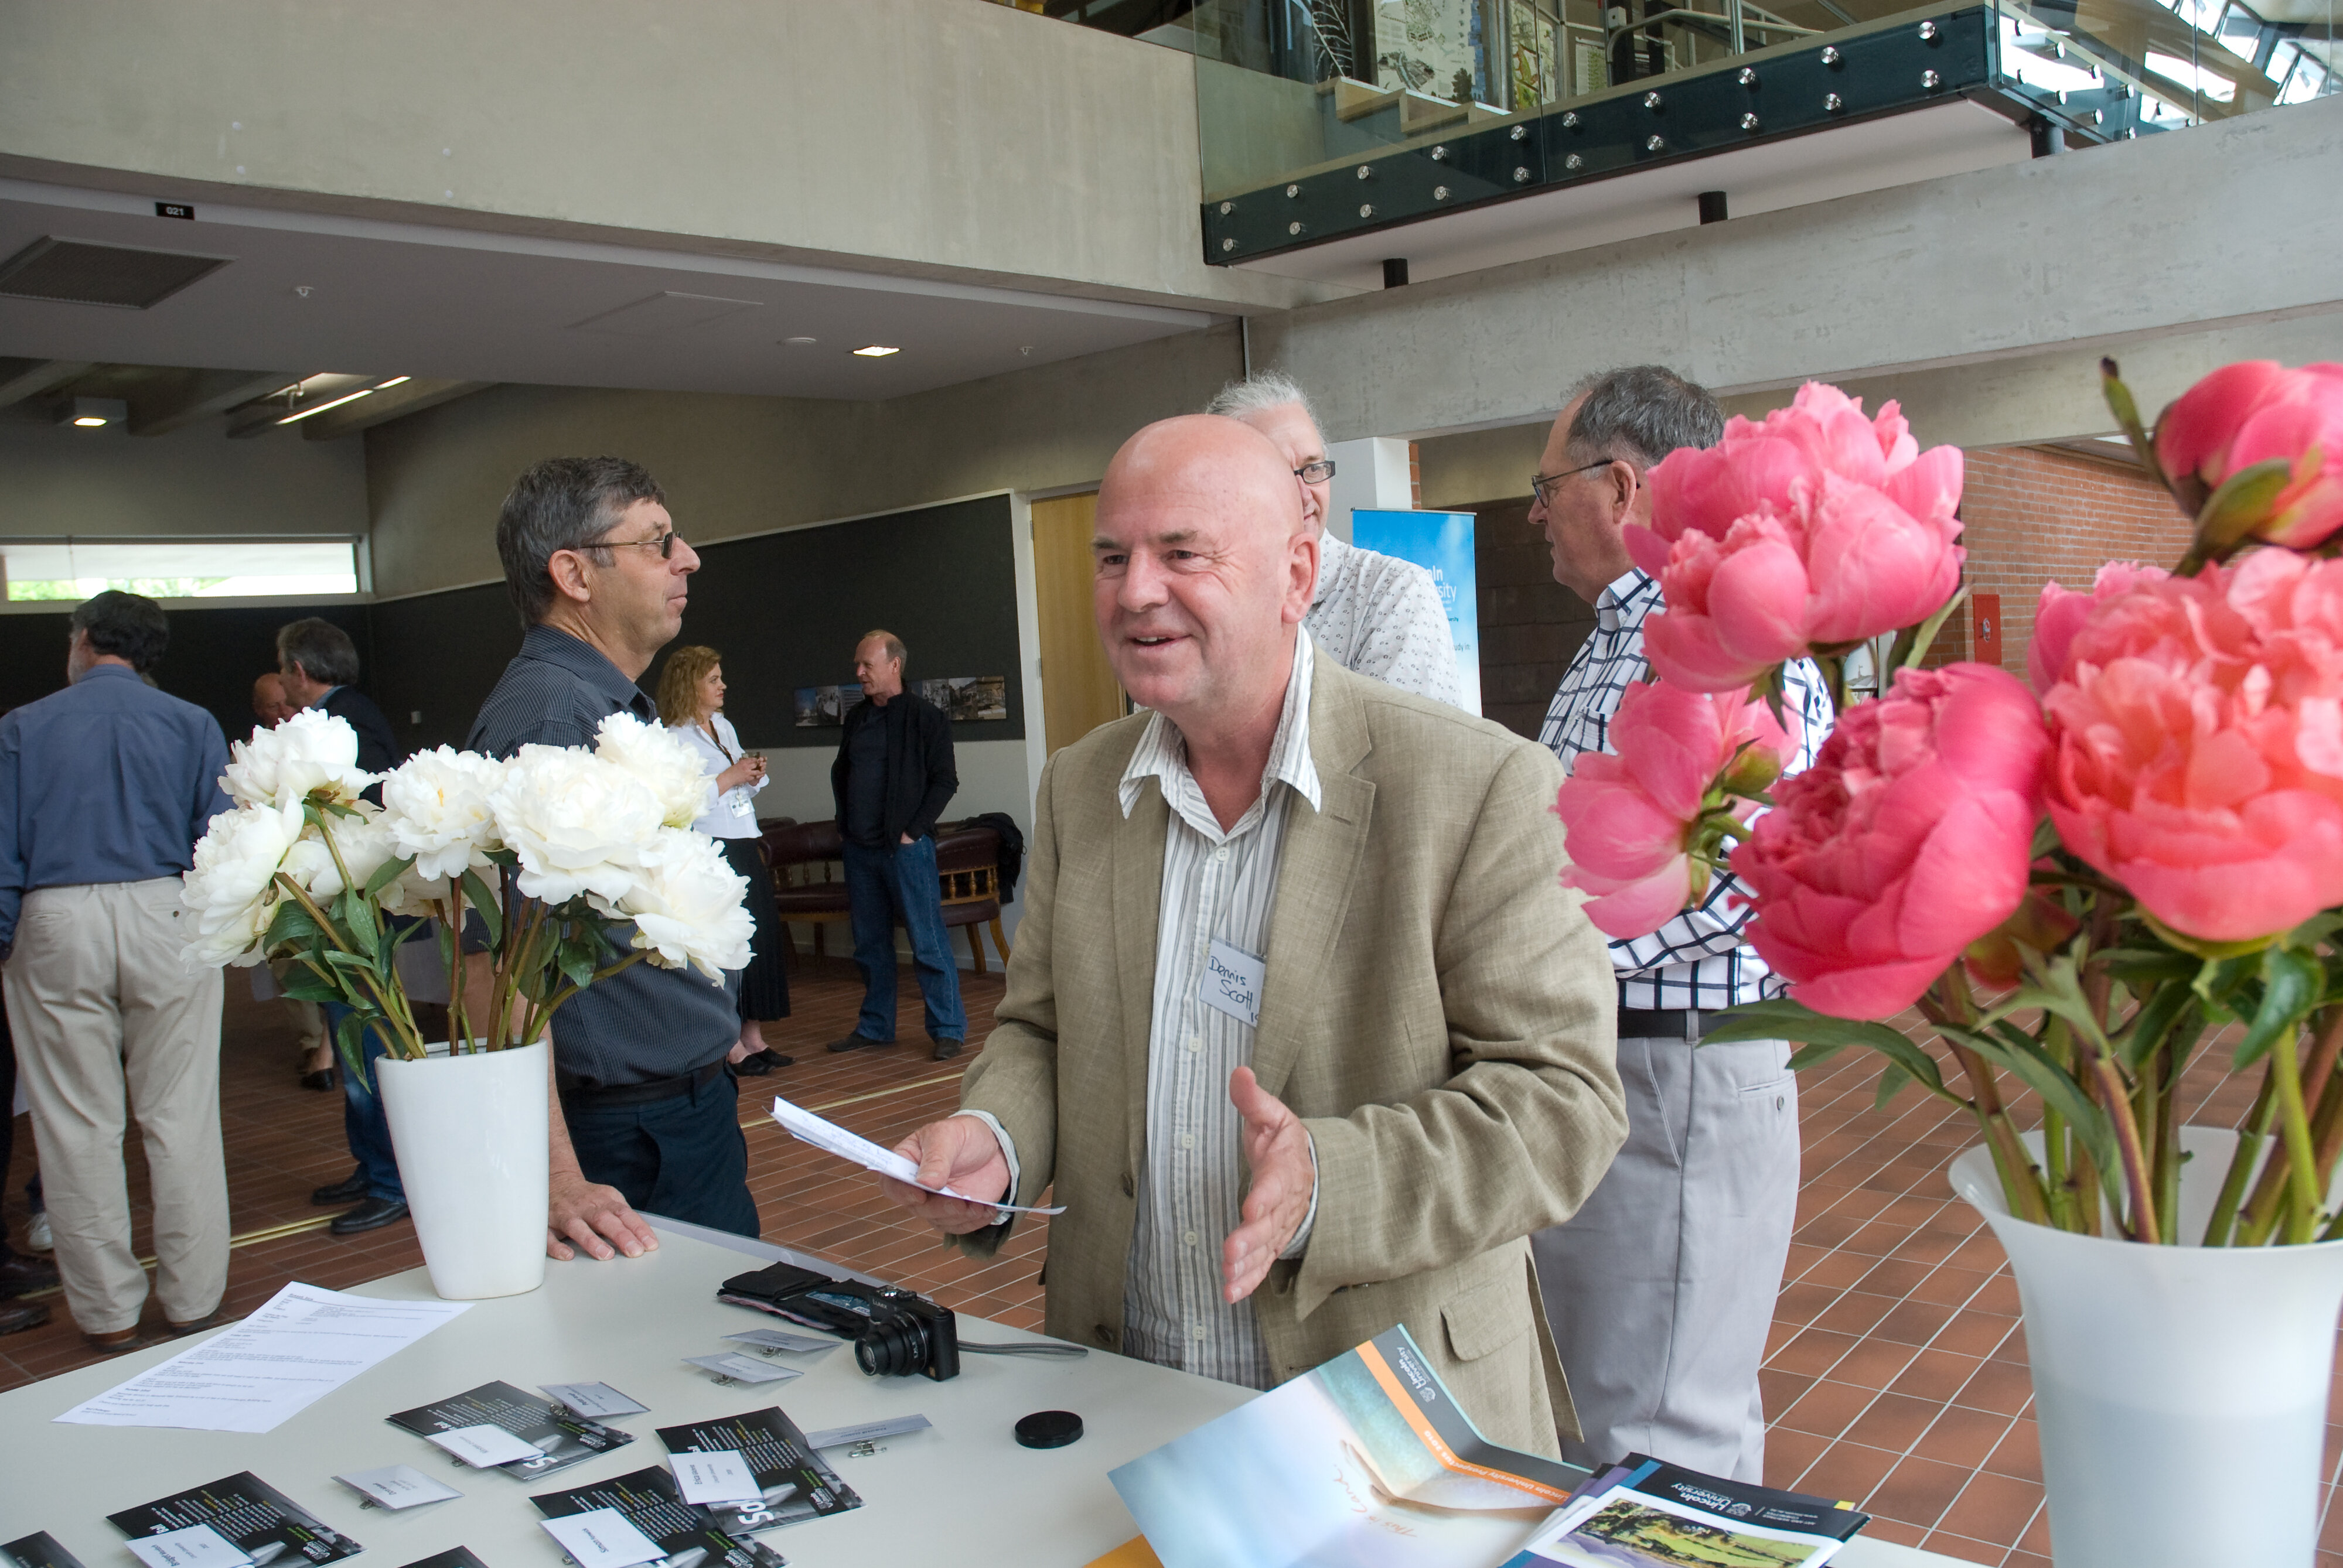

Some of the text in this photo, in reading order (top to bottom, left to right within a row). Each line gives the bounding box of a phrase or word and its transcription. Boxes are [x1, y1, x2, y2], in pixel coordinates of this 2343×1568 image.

[166, 206, 184, 216] 021
[1208, 955, 1246, 986] Dennis
[1219, 979, 1253, 1011] Scott
[1397, 1347, 1427, 1388] University
[1399, 1358, 1423, 1390] Lincoln
[1424, 1430, 1444, 1453] 2010
[1441, 1451, 1489, 1475] Prospectus
[1488, 1470, 1535, 1490] University
[1670, 1482, 1732, 1506] University
[1679, 1492, 1726, 1511] Lincoln
[593, 1539, 609, 1553] Simon
